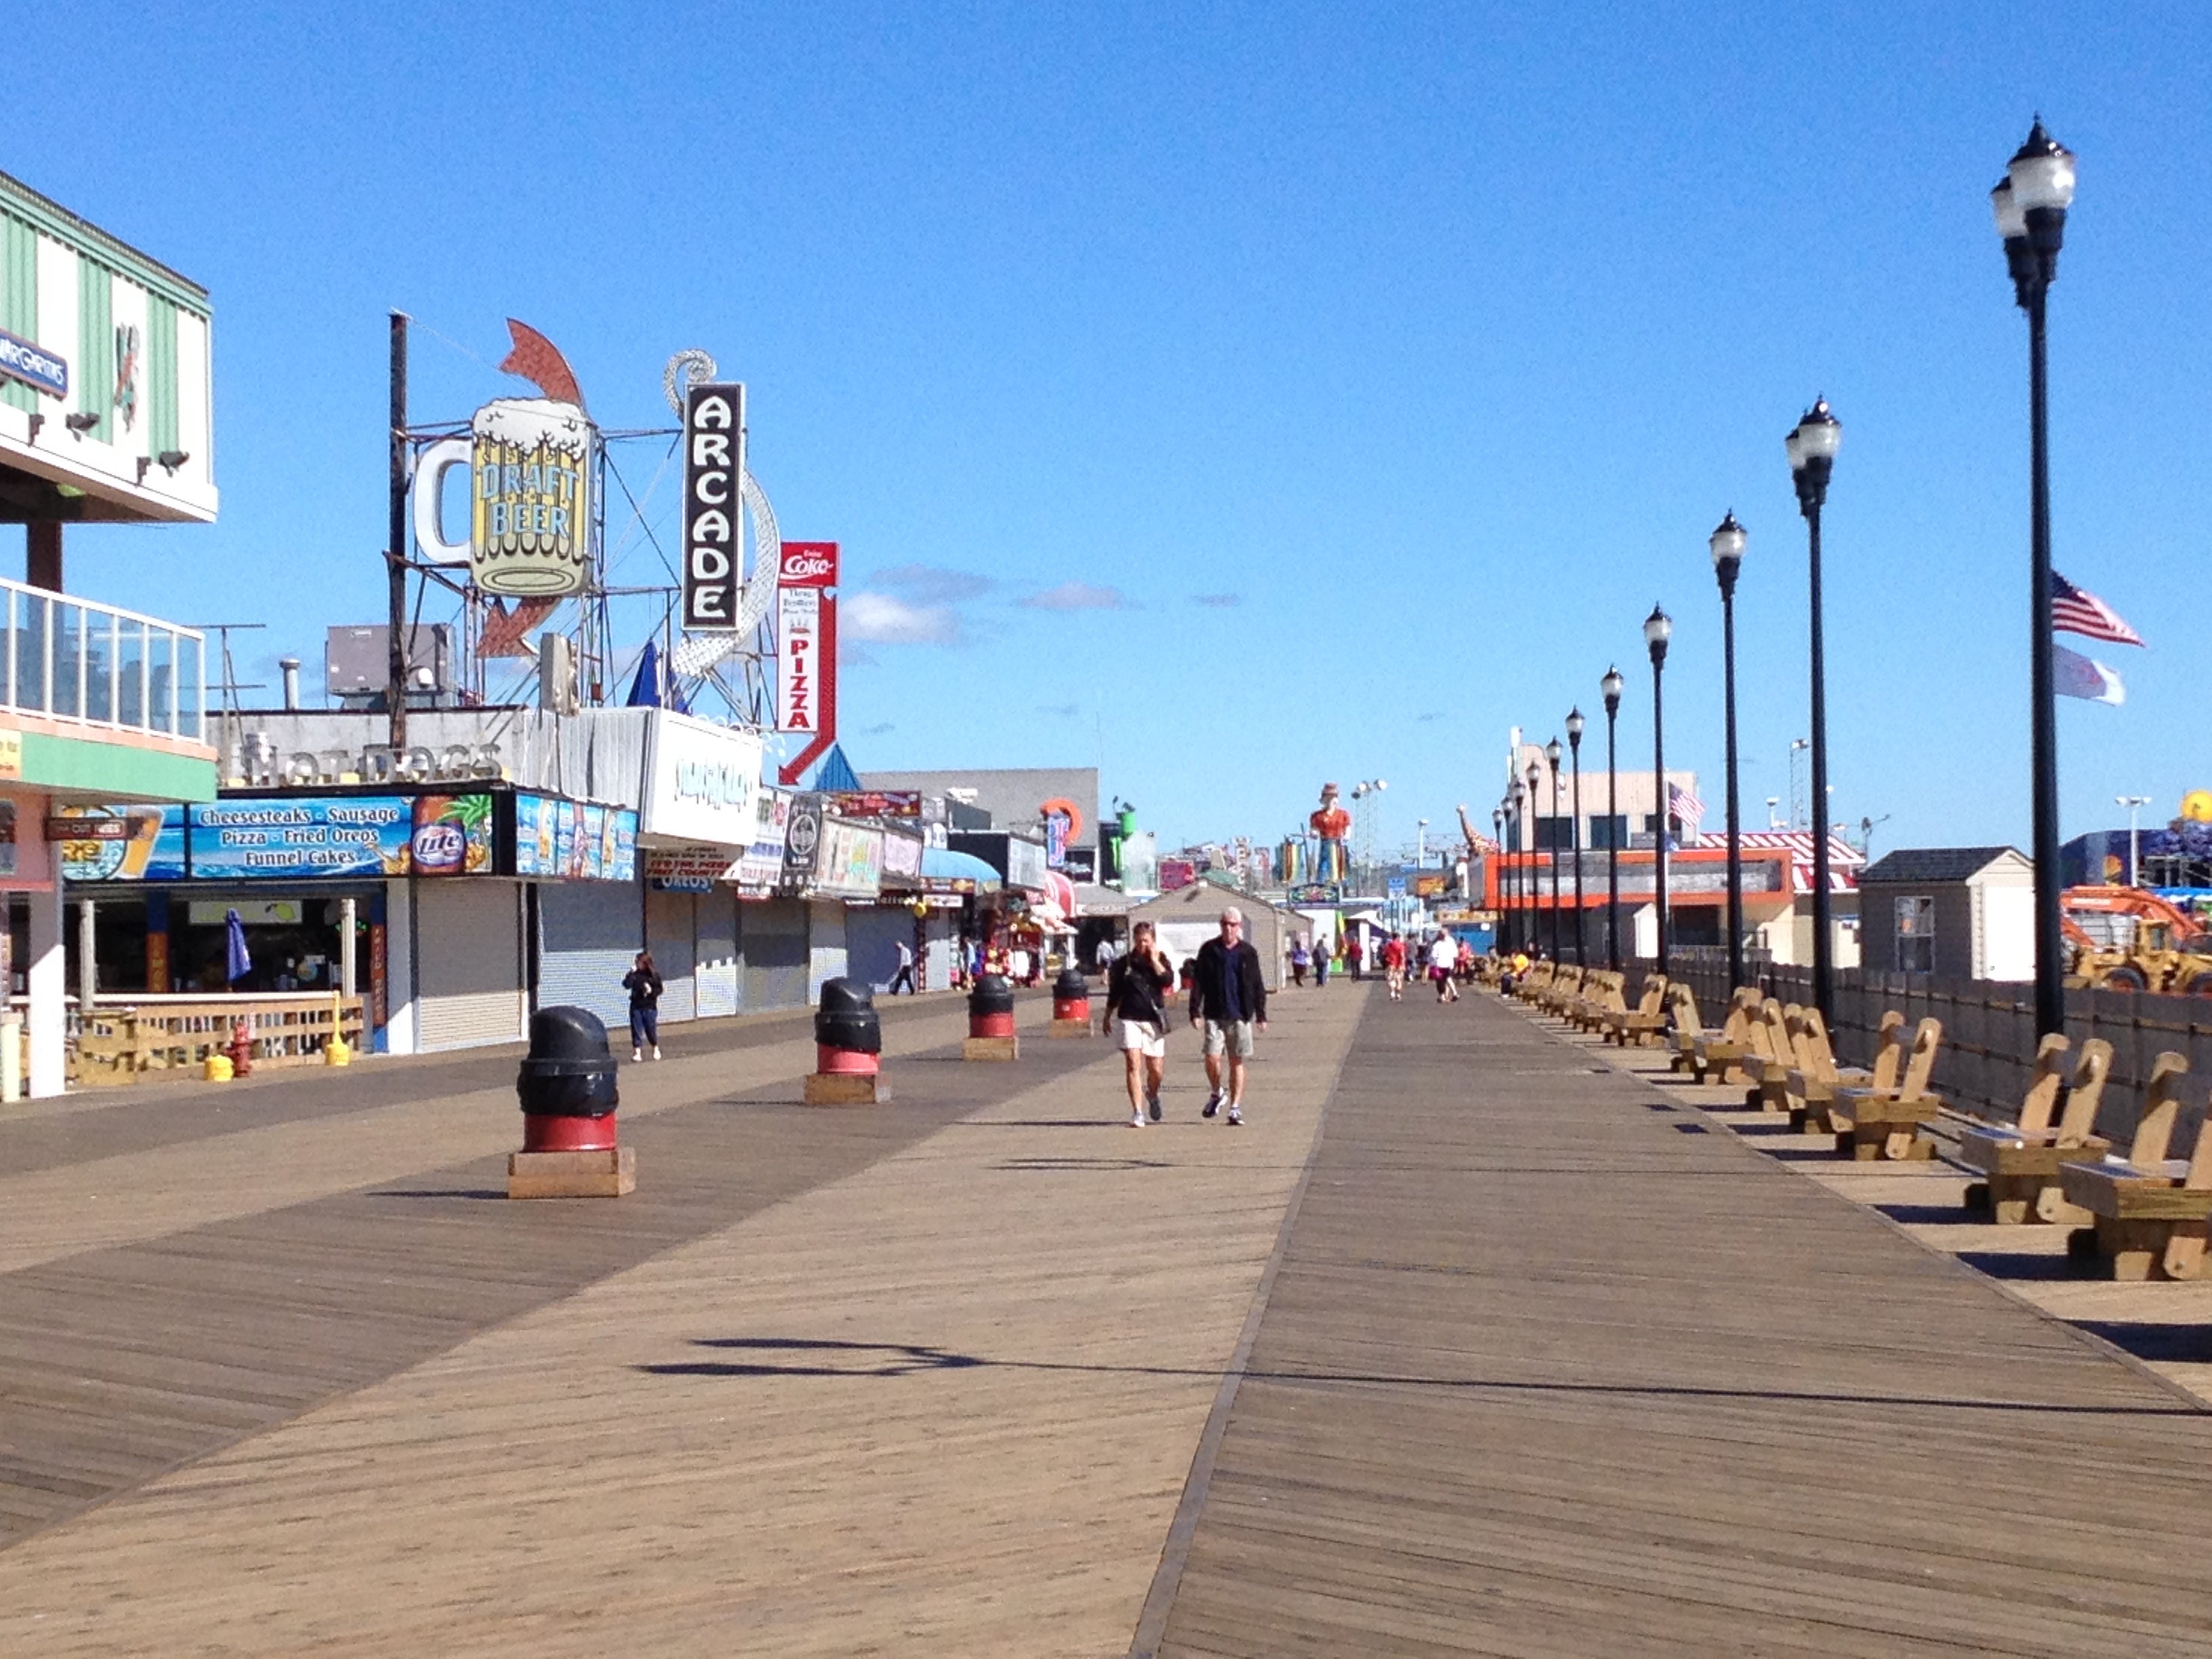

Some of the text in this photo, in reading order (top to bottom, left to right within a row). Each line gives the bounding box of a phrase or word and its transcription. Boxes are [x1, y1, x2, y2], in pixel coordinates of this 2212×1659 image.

[483, 464, 579, 499] DRAFT
[492, 503, 571, 539] BEER
[692, 396, 732, 619] ARCADE
[784, 555, 834, 576] Coke
[787, 639, 811, 728] PIZZA
[240, 743, 502, 788] HOT DOGS
[200, 808, 312, 825] Cheesesteaks
[327, 806, 399, 825] Sausage
[221, 830, 266, 846] Pizza
[284, 829, 327, 844] Fried
[331, 828, 379, 843] Oreos
[414, 834, 460, 855] Lite
[245, 850, 356, 866] Funnel Cakes
